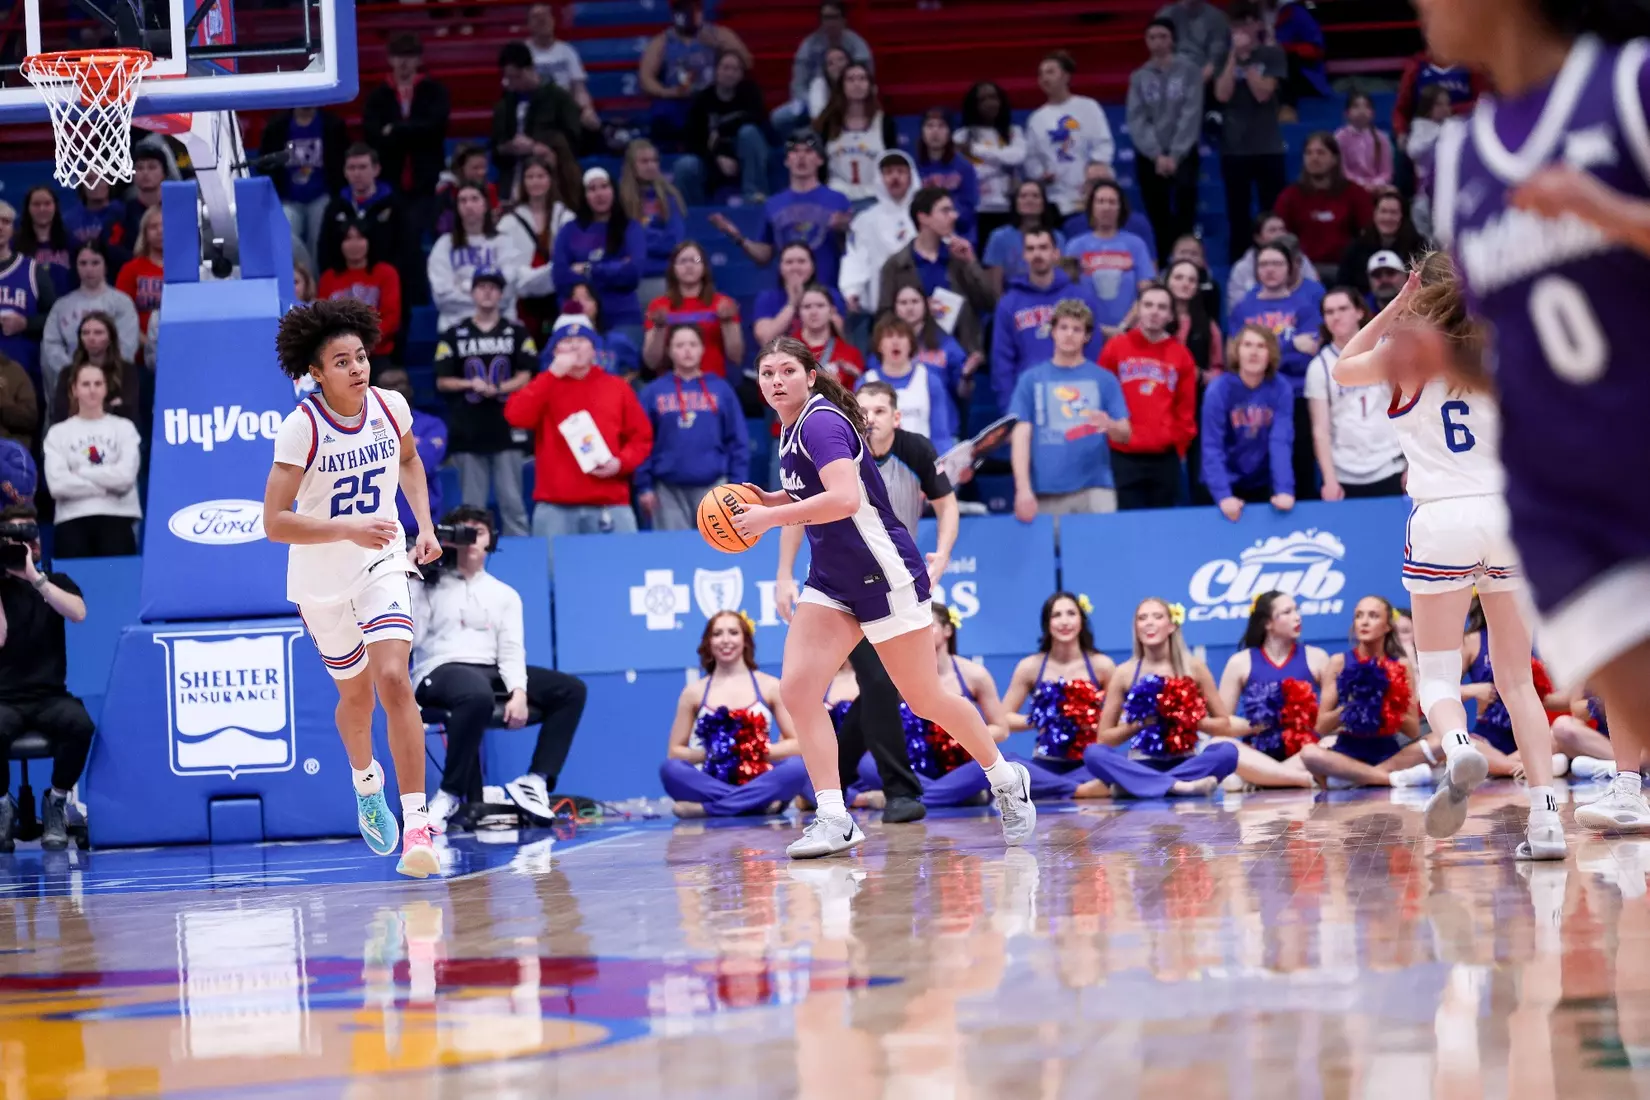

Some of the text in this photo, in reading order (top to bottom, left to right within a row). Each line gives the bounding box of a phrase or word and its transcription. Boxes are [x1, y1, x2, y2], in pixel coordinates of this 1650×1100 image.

[1528, 272, 1610, 386] 0
[457, 337, 515, 357] KANSAS
[1441, 401, 1476, 453] 6
[318, 438, 396, 472] JAYHAWKS
[330, 466, 387, 519] 25
[193, 507, 260, 535] Ford
[1188, 556, 1346, 606] Club
[1299, 600, 1344, 616] SH
[179, 668, 280, 690] SHELTER
[180, 689, 279, 705] INSURANCE
